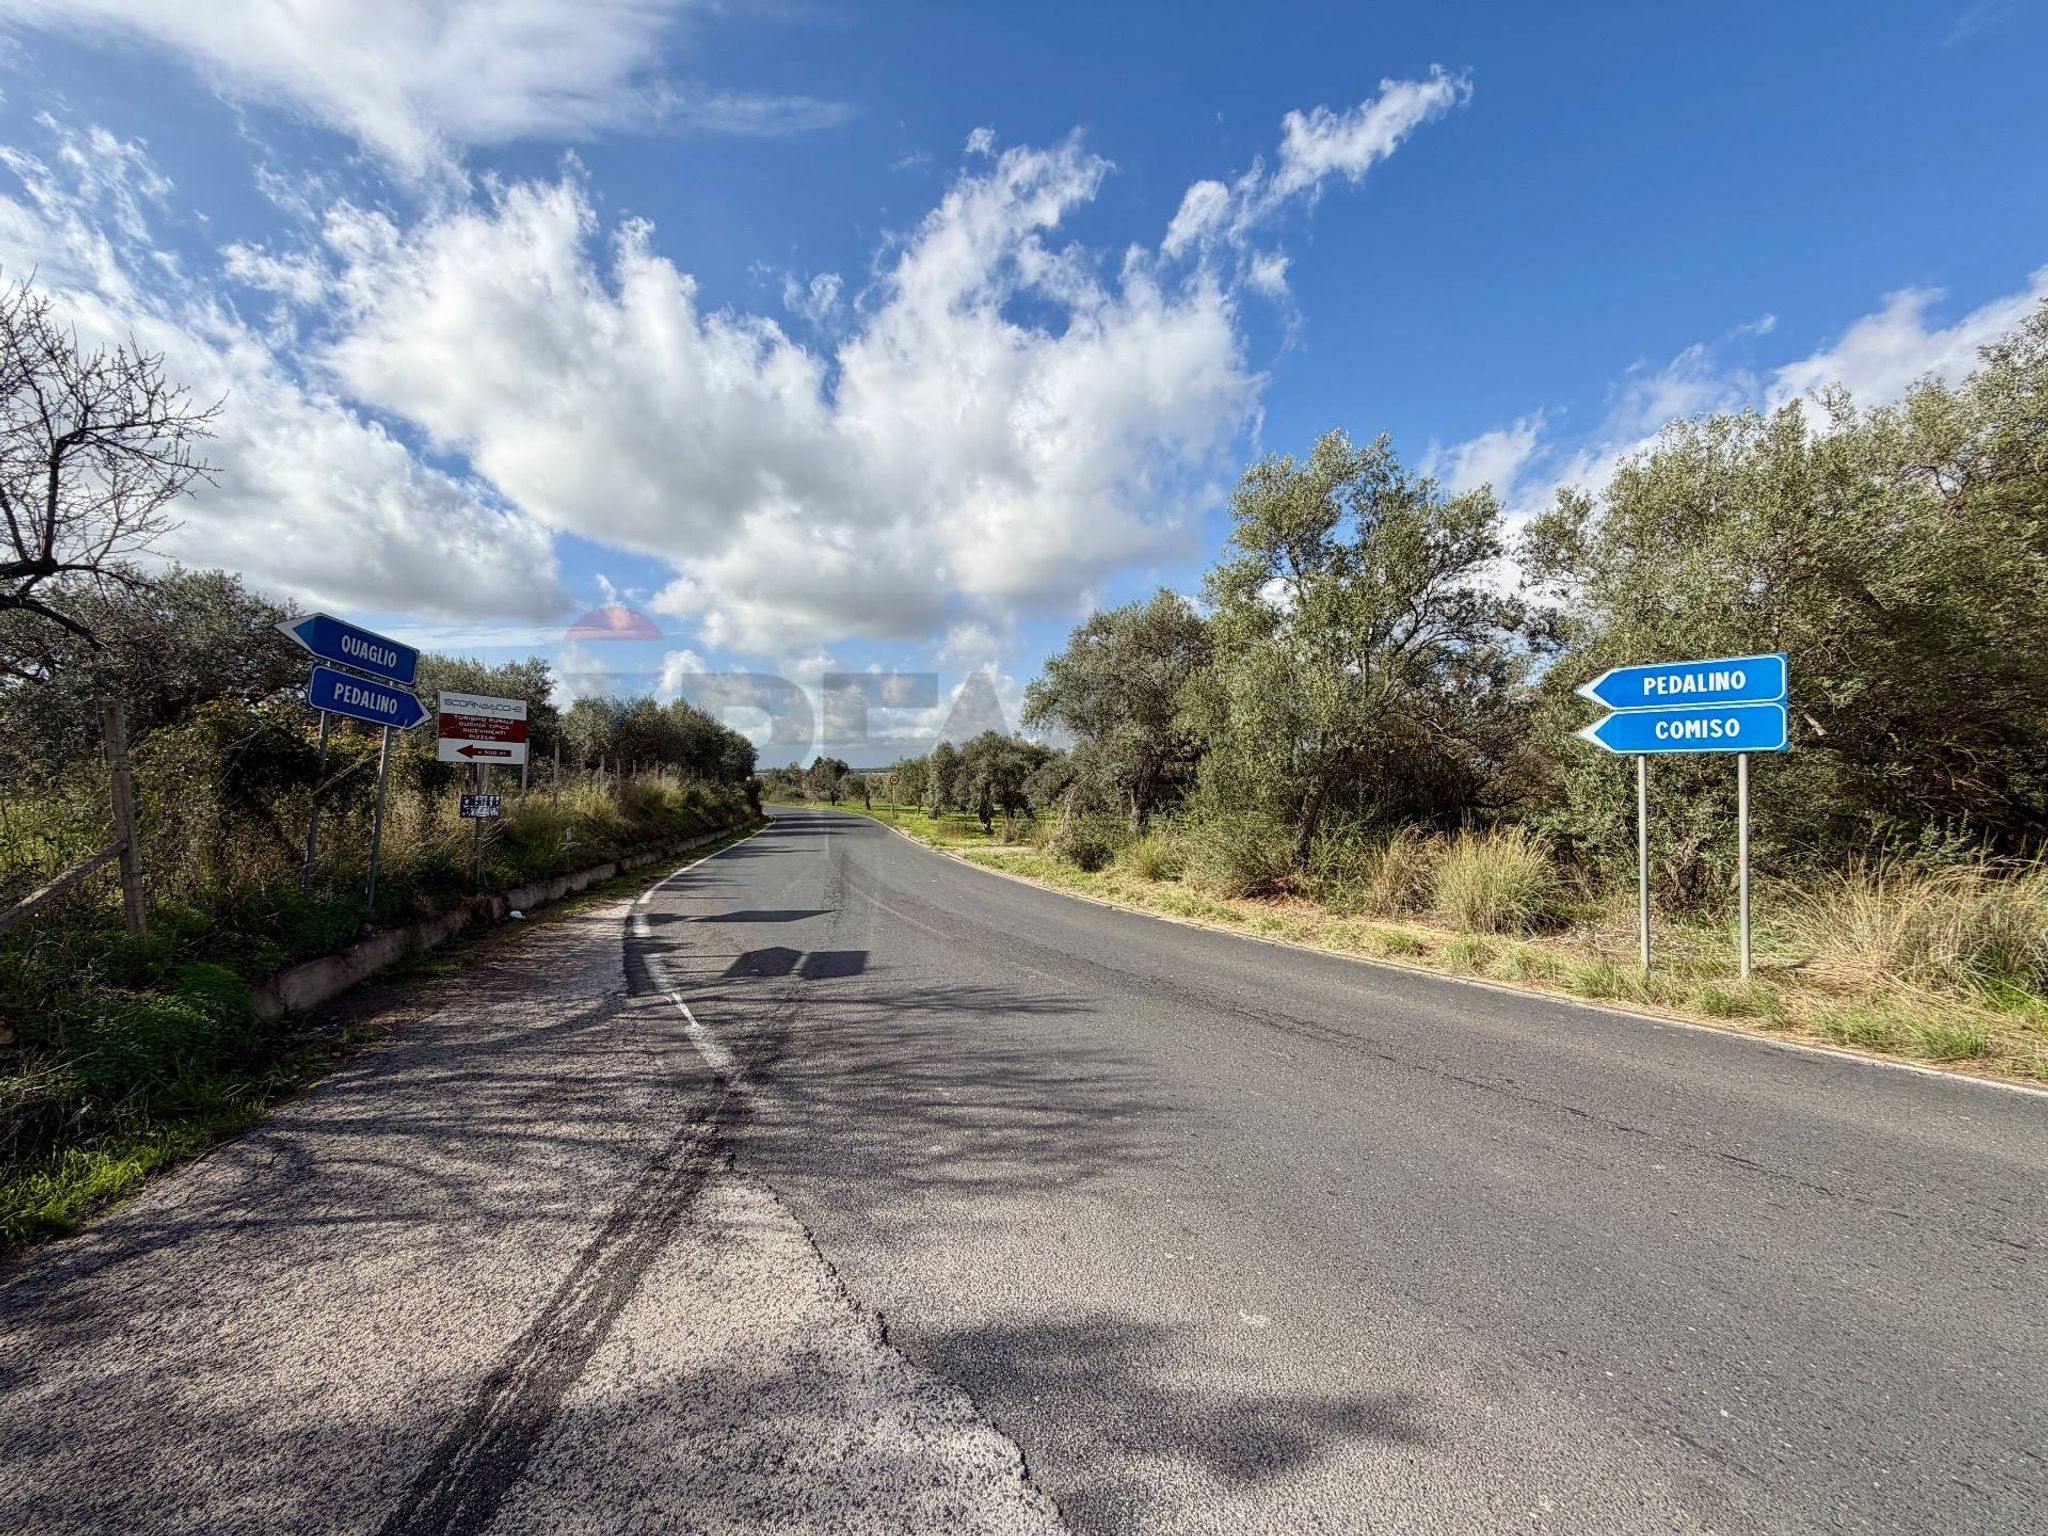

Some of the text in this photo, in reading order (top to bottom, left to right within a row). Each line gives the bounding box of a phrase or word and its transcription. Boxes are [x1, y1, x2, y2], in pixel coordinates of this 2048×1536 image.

[341, 634, 397, 668] QUAGLIO
[1643, 670, 1747, 696] PEDALINO
[333, 682, 398, 715] PEDALINO
[1655, 718, 1741, 740] COMISO
